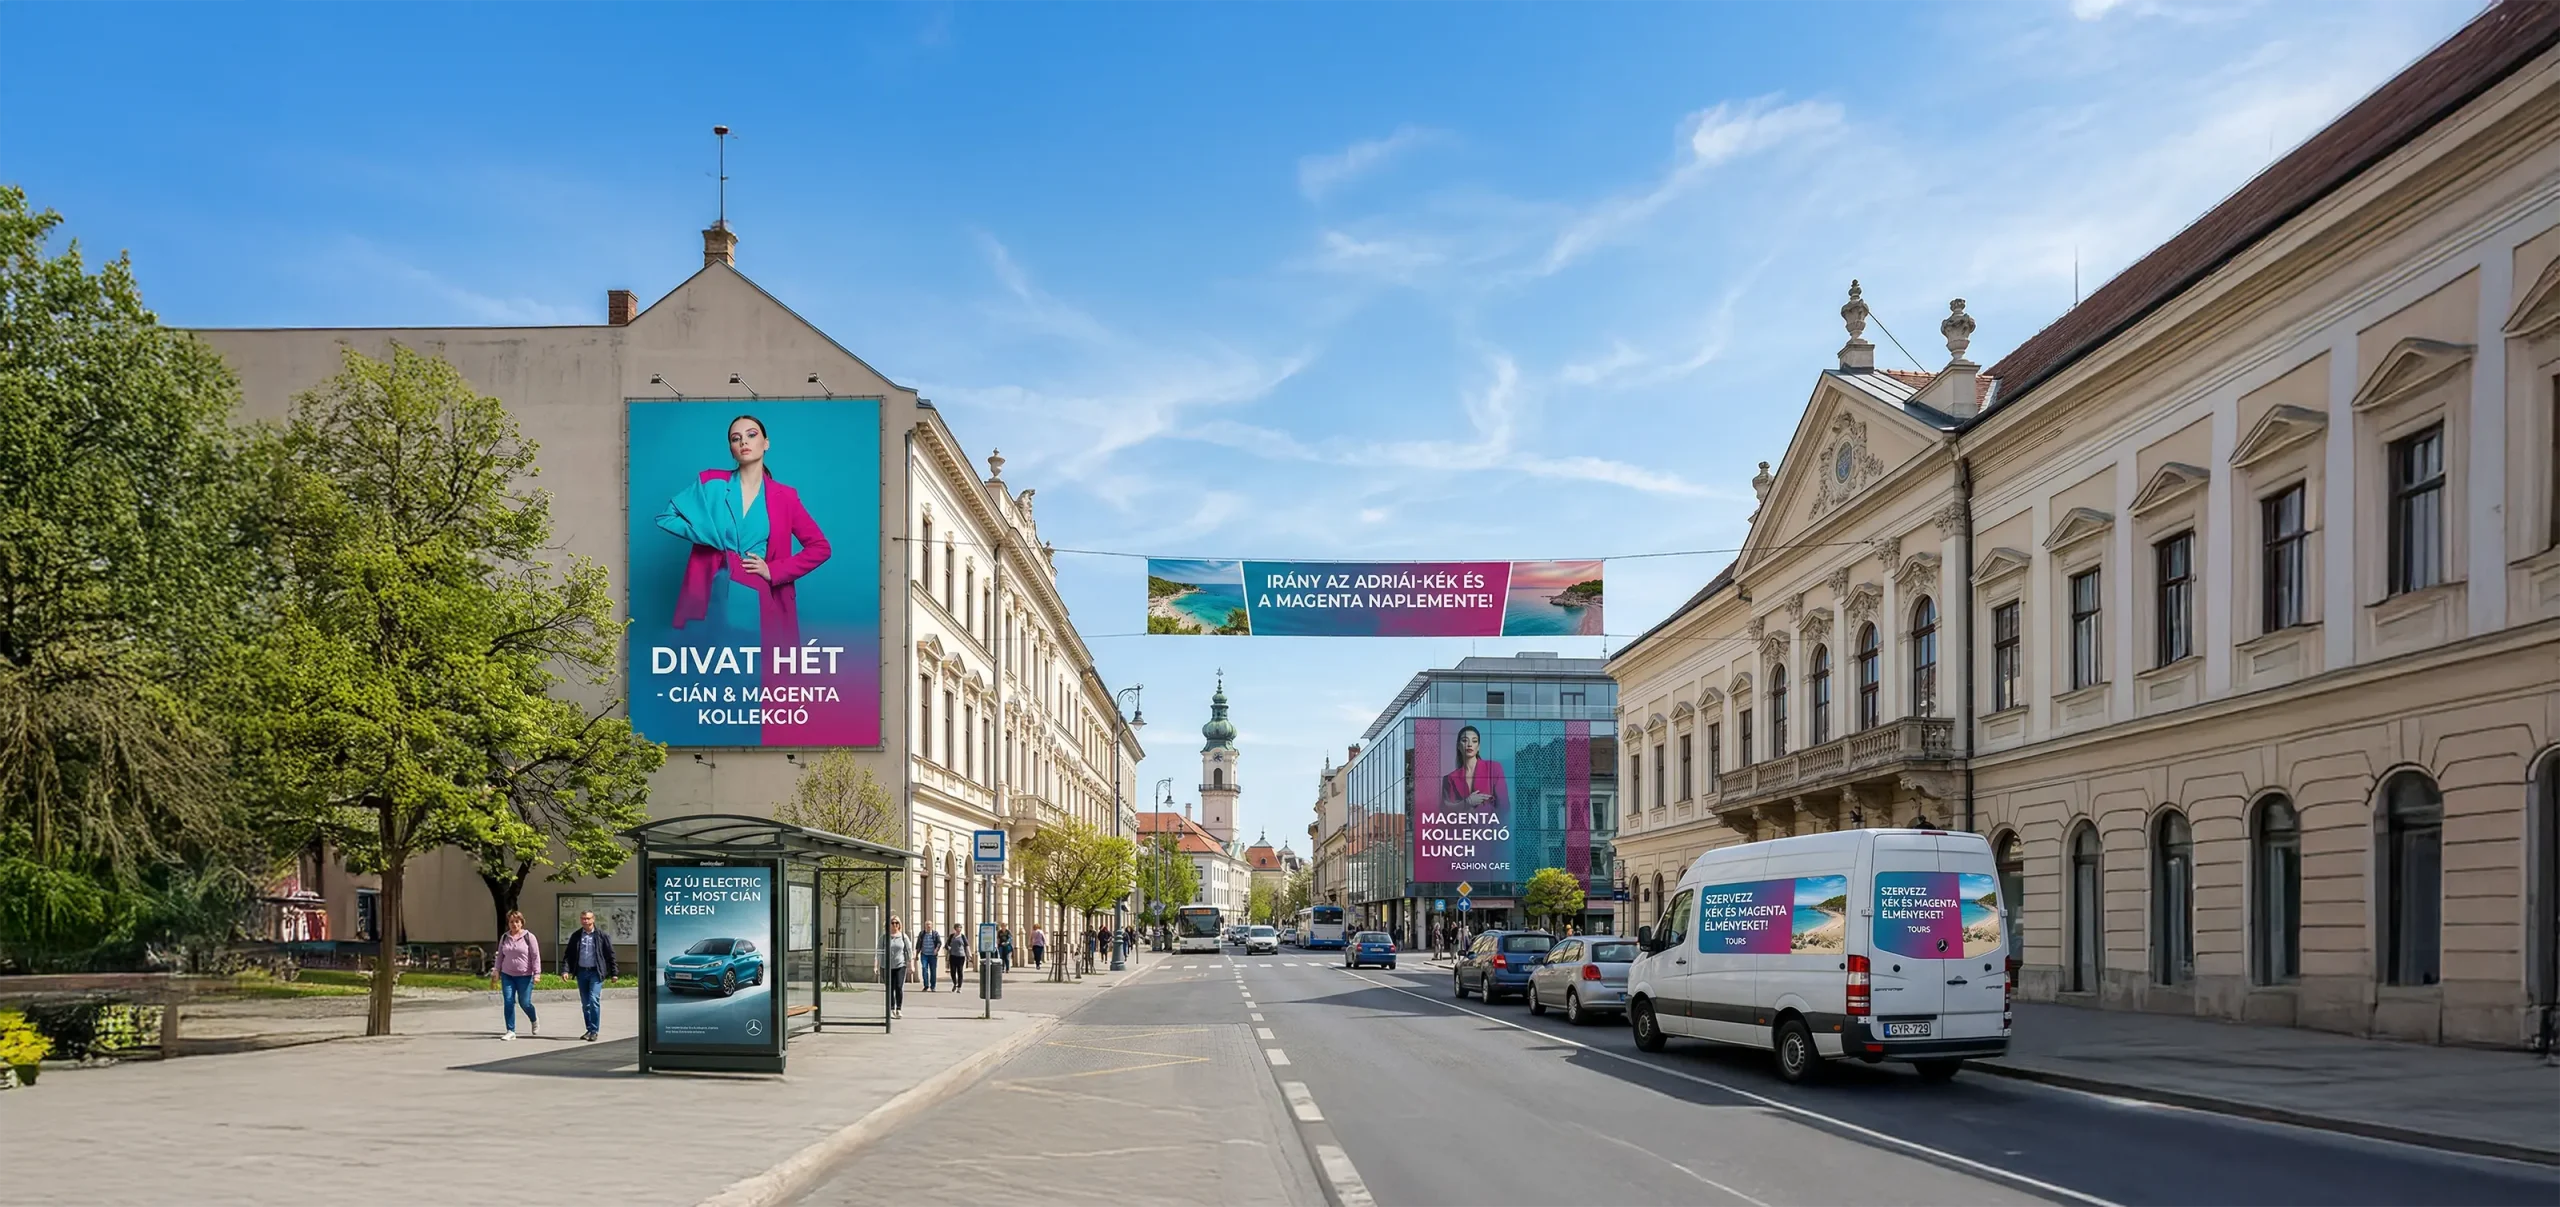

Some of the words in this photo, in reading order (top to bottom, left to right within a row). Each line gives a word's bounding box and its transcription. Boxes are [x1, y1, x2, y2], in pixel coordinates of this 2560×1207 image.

[1266, 570, 1321, 589] IRÁNY
[1326, 574, 1350, 589] AZ
[1354, 570, 1458, 589] ADRIÁI-KÉK
[1463, 570, 1485, 589] ÉS
[1258, 594, 1272, 608] A
[1278, 594, 1363, 608] MAGENTA
[1368, 594, 1494, 608] NAPLEMENTE!
[652, 646, 761, 675] DIVAT
[773, 638, 844, 675] HÉT
[669, 683, 716, 703] CIÁN
[724, 687, 736, 703] &
[742, 687, 840, 703] MAGENTA
[698, 705, 808, 725] KOLLEKCIÓ
[1422, 813, 1500, 824] MAGENTA
[1422, 826, 1510, 840] KOLLEKCIÓ
[1422, 845, 1475, 857] LUNCH
[1451, 862, 1487, 870] FASHION
[1489, 862, 1510, 870] CAFE
[665, 878, 681, 887] AZ
[684, 875, 699, 888] ÚJ
[703, 878, 761, 887] ELECTRIC
[665, 892, 681, 901] GT
[693, 892, 727, 901] MOST
[731, 889, 761, 901] CIÁN
[1881, 886, 1927, 897] SZERVEZZ
[1705, 892, 1753, 905] SZERVEZZ
[1881, 896, 1899, 908] KÉK
[1902, 896, 1912, 908] ÉS
[1914, 898, 1958, 908] MAGENTA
[665, 903, 715, 915] KÉKBEN
[1705, 906, 1723, 918] KÉK
[1725, 906, 1736, 917] ÉS
[1738, 905, 1787, 918] MAGENTA
[1881, 908, 1945, 919] ÉLMÉNYEKET!
[1704, 918, 1769, 931] ÉLMÉNYEKET!
[1907, 925, 1931, 934] TOURS
[1725, 937, 1746, 946] TOURS
[1891, 1024, 1929, 1034] GYR-729
